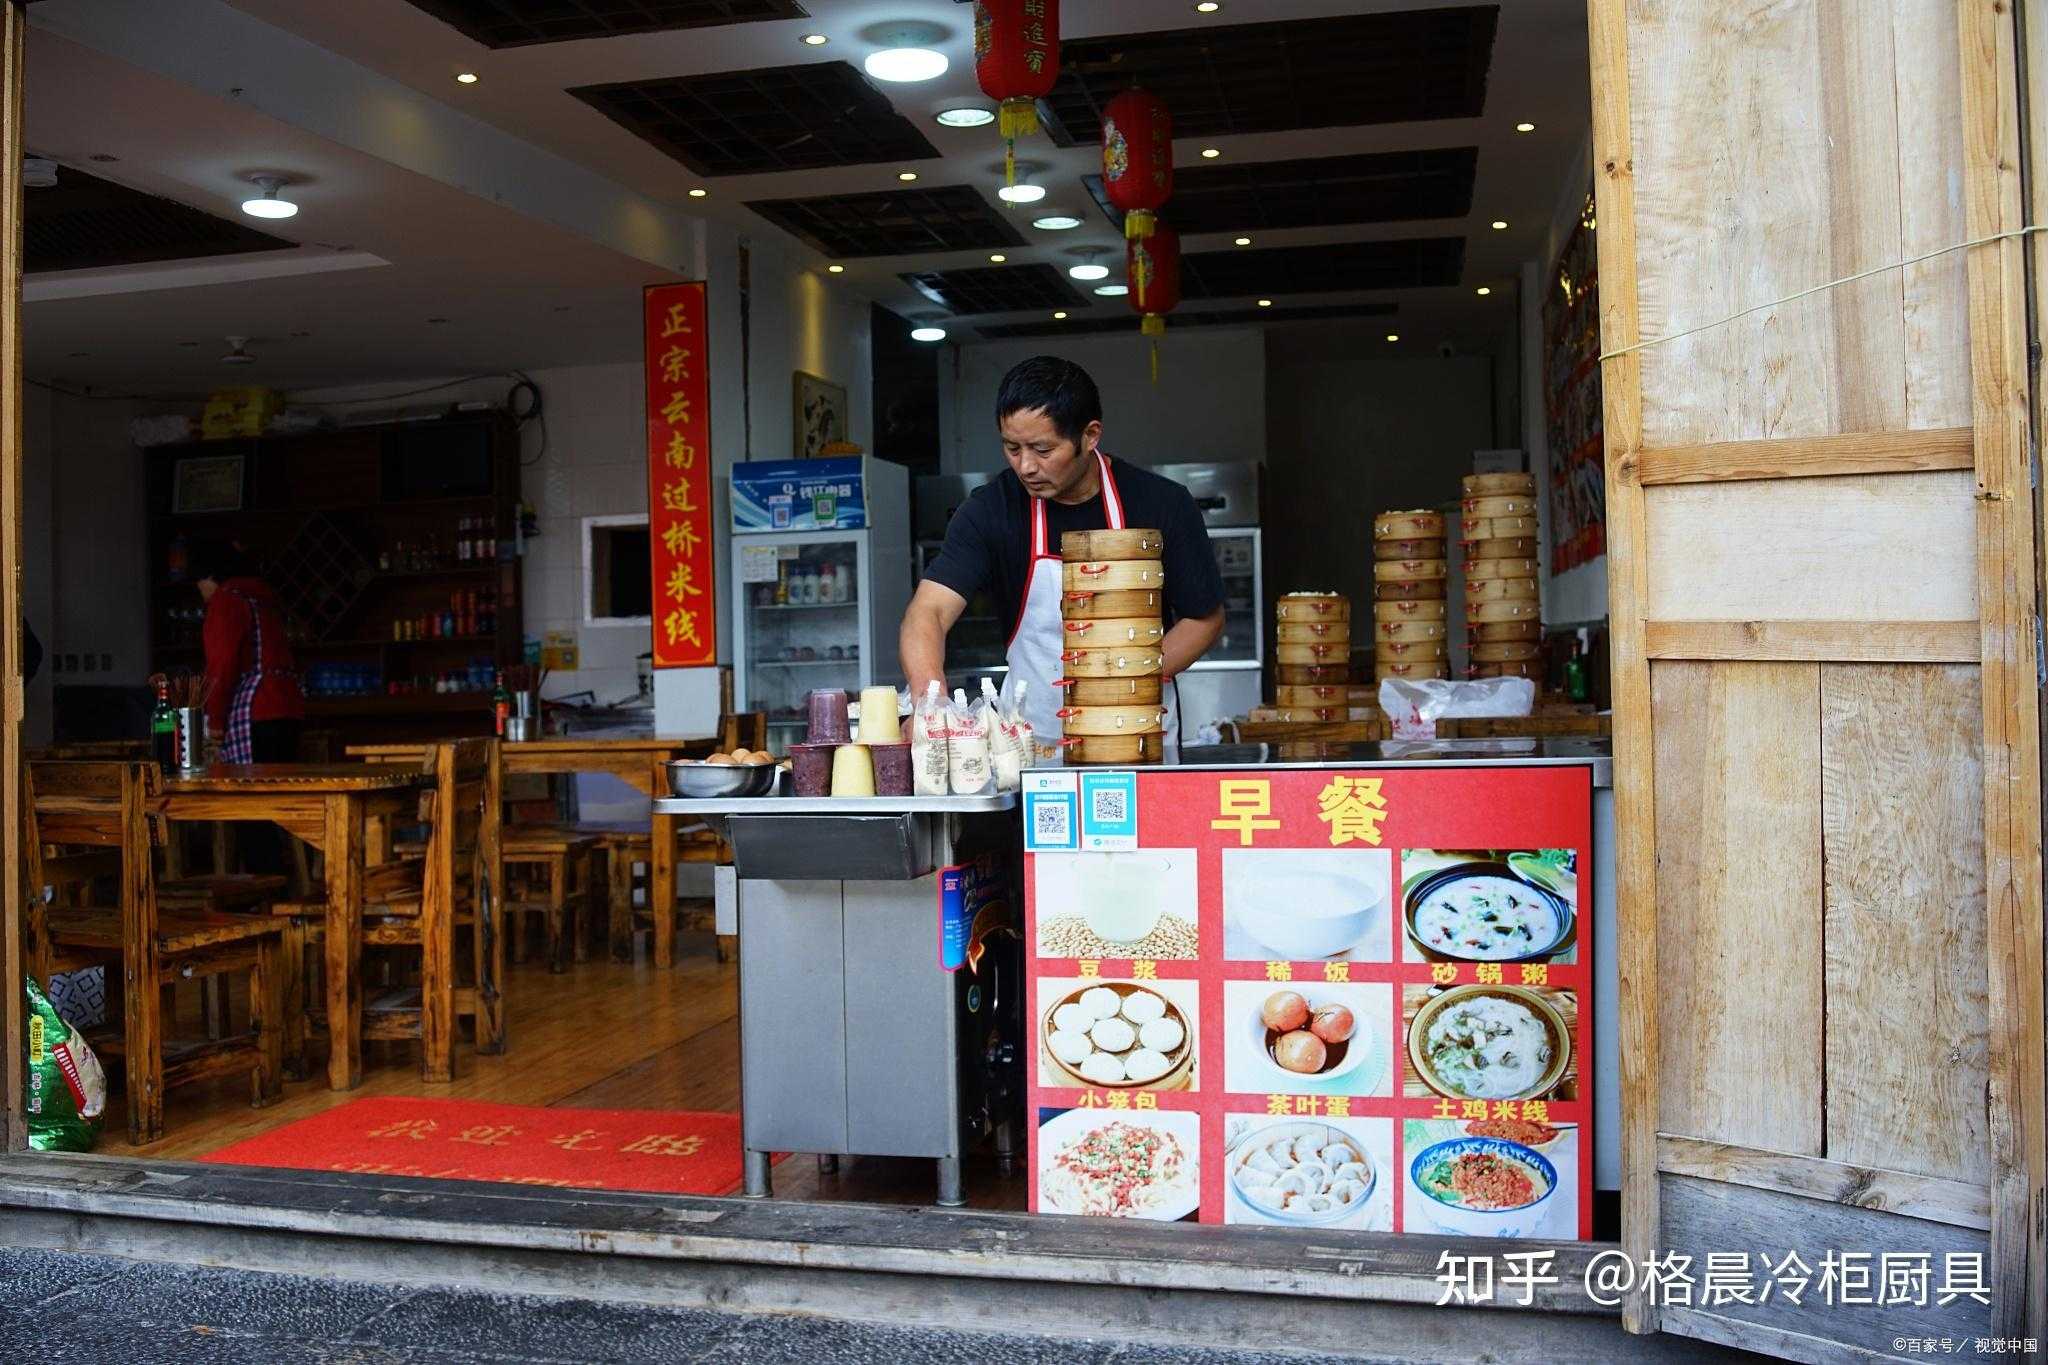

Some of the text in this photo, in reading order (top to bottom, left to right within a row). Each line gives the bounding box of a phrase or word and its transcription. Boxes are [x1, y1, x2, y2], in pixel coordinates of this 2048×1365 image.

[660, 302, 704, 648] 正宗云南过桥米线
[1211, 775, 1388, 847] 早餐
[1078, 960, 1158, 981] 豆浆
[1265, 961, 1351, 983] 稀饭
[1432, 963, 1548, 985] 砂锅粥
[1078, 1090, 1159, 1111] 小笼包
[1267, 1094, 1351, 1117] 茶叶蛋
[1432, 1098, 1550, 1122] 土鸡米线
